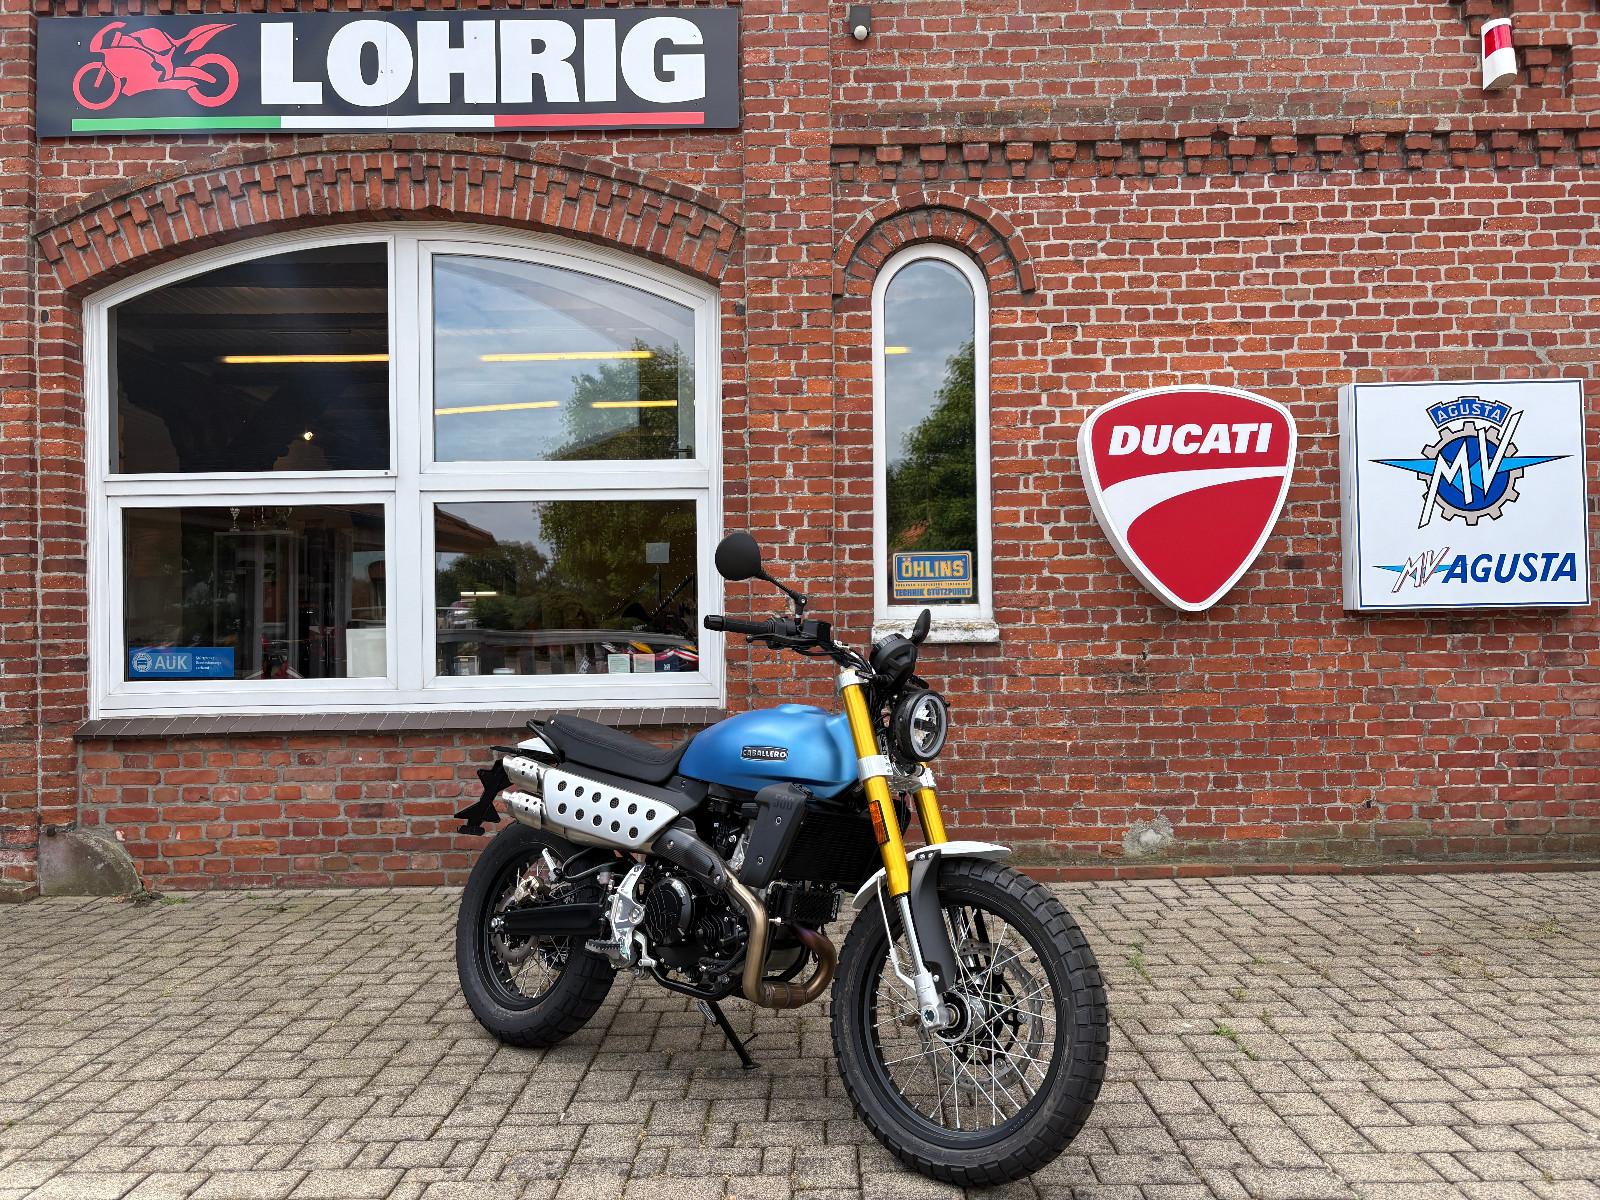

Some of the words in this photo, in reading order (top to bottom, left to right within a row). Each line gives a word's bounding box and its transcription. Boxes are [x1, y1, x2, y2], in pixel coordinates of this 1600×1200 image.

[260, 16, 706, 108] LOHRIG
[1436, 402, 1501, 422] AGUSTA
[1108, 422, 1273, 455] DUCATI
[1417, 410, 1524, 529] MV
[902, 557, 965, 578] ÖHLINS
[1442, 552, 1577, 583] AGUSTA
[896, 588, 924, 597] TECHNIK
[154, 655, 188, 670] AUK
[742, 749, 787, 758] CABALLERO
